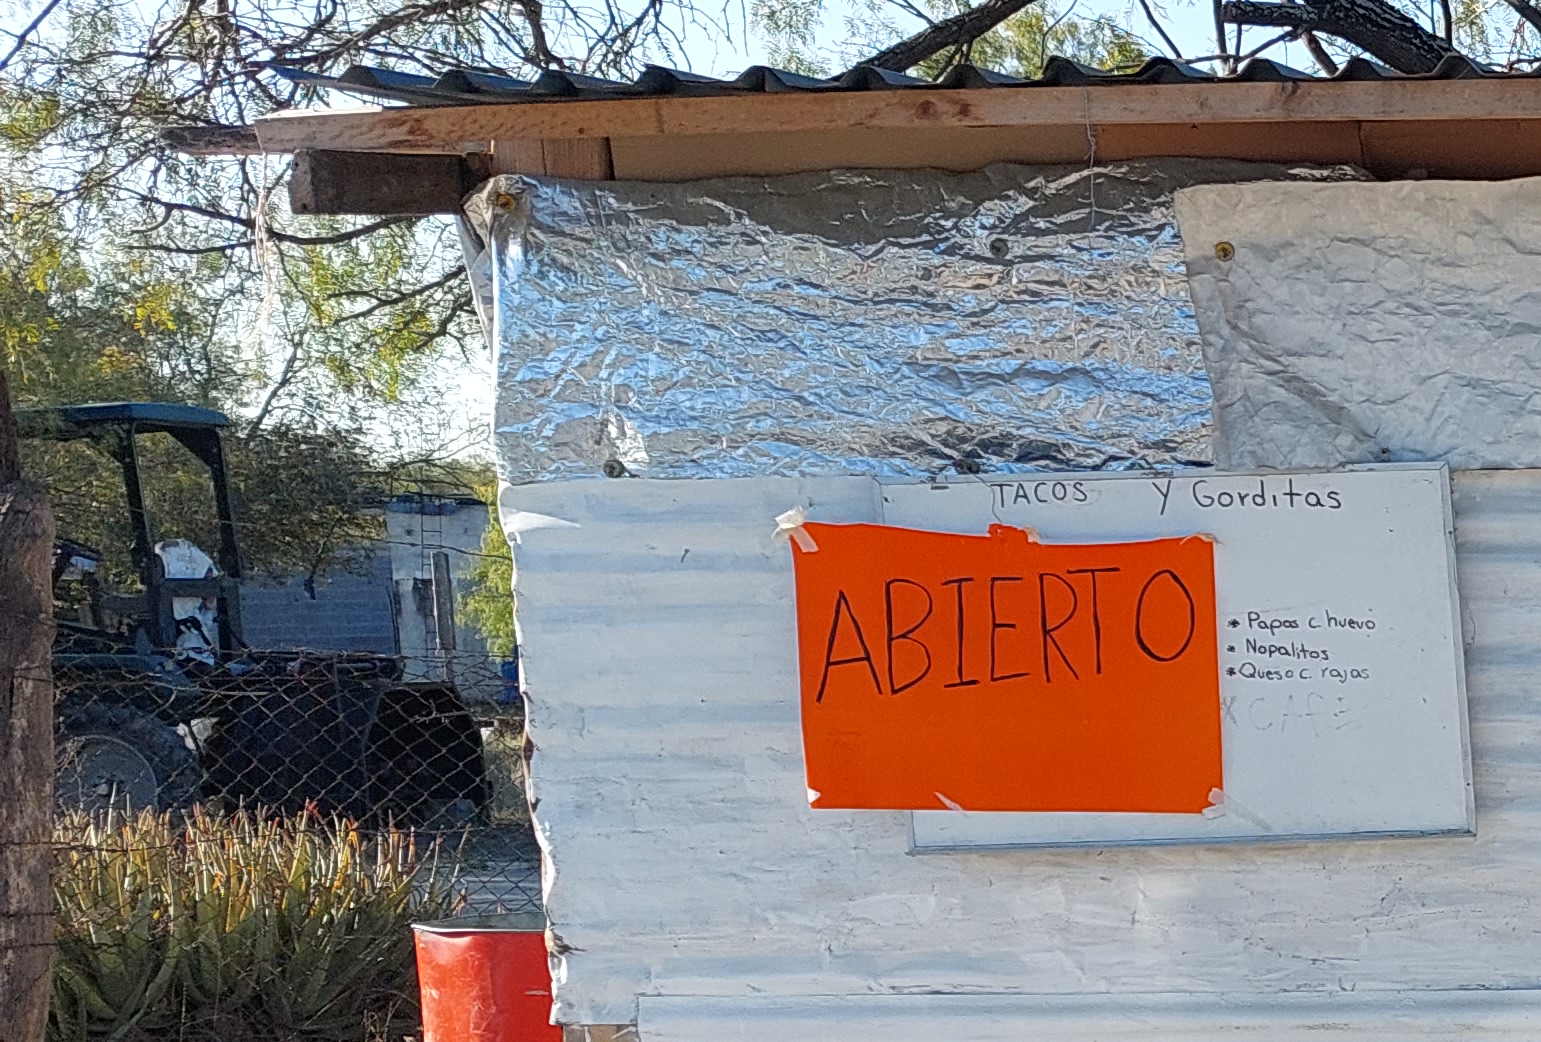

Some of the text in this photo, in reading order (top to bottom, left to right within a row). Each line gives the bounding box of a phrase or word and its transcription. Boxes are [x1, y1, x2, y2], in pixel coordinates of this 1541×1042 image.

[990, 480, 1088, 509] TACOS
[1191, 477, 1342, 510] Gorditas
[815, 566, 1195, 704] ABIERTO
[1247, 610, 1299, 637] Papas
[1324, 608, 1376, 630] huevo
[1245, 637, 1330, 661] Nopalitos
[1238, 661, 1294, 681] Queso
[1319, 667, 1370, 685] rajas
